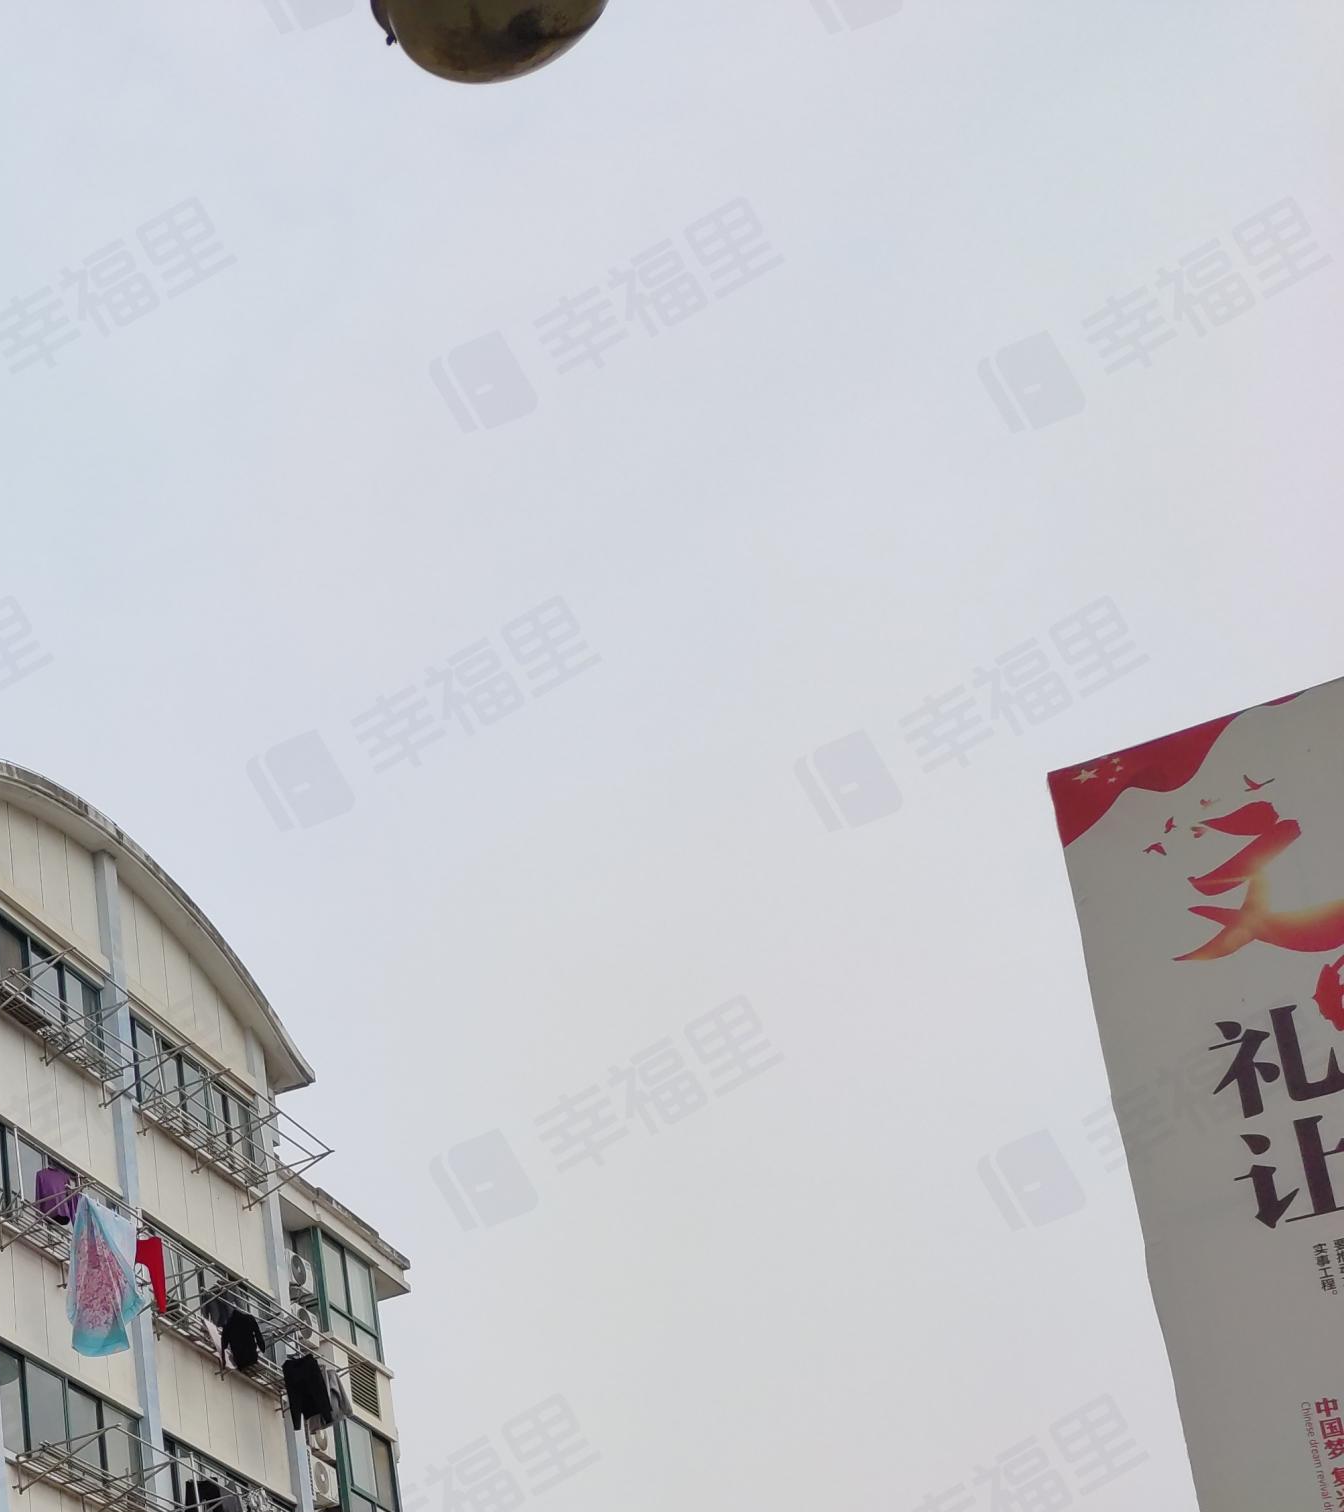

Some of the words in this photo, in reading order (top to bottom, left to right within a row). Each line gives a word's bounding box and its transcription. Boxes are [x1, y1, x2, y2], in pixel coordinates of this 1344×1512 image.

[1301, 1401, 1316, 1438] Chinese
[1310, 1439, 1322, 1468] dream
[1317, 1470, 1332, 1500] revival
